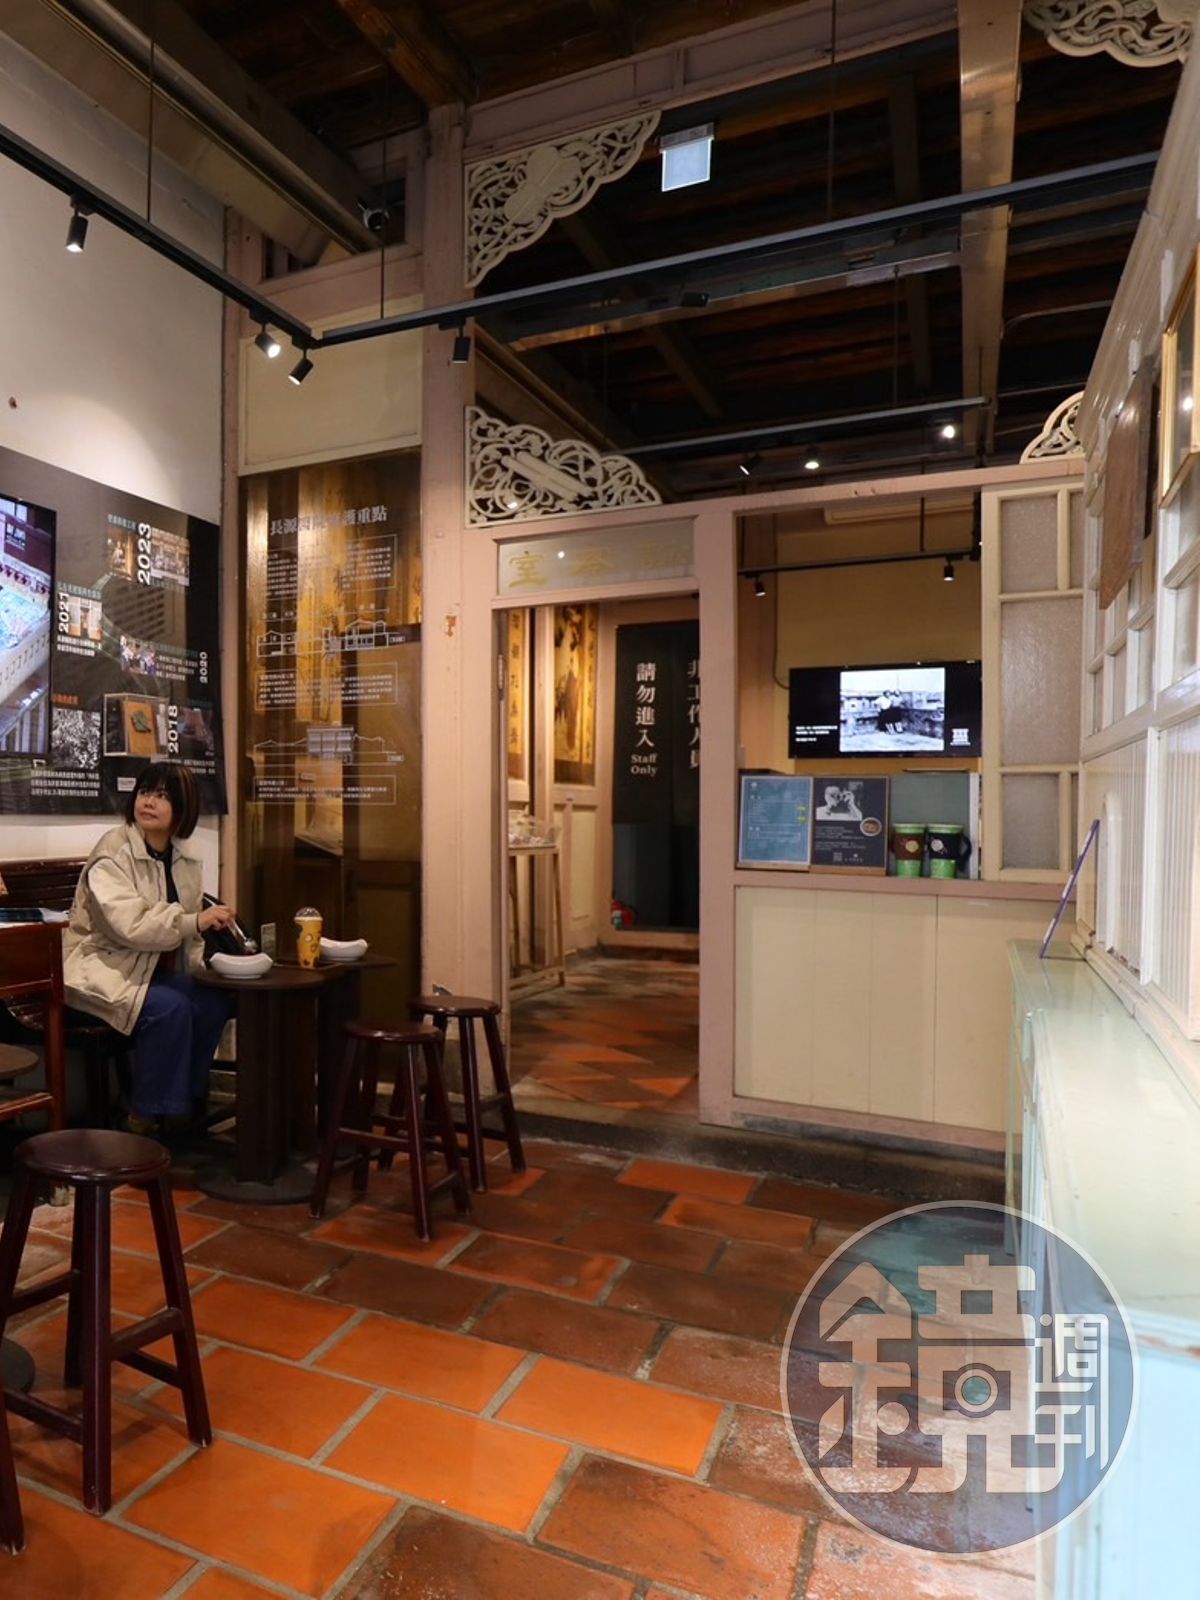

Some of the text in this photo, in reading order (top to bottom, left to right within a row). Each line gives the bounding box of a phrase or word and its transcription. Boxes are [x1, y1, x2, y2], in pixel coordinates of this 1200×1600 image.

[137, 523, 152, 586] 2023
[58, 592, 70, 633] 2021
[199, 651, 209, 684] 2020
[636, 662, 656, 748] 請勿進入
[167, 705, 179, 754] 2018
[630, 765, 657, 777] Only
[631, 753, 657, 764] Staff
